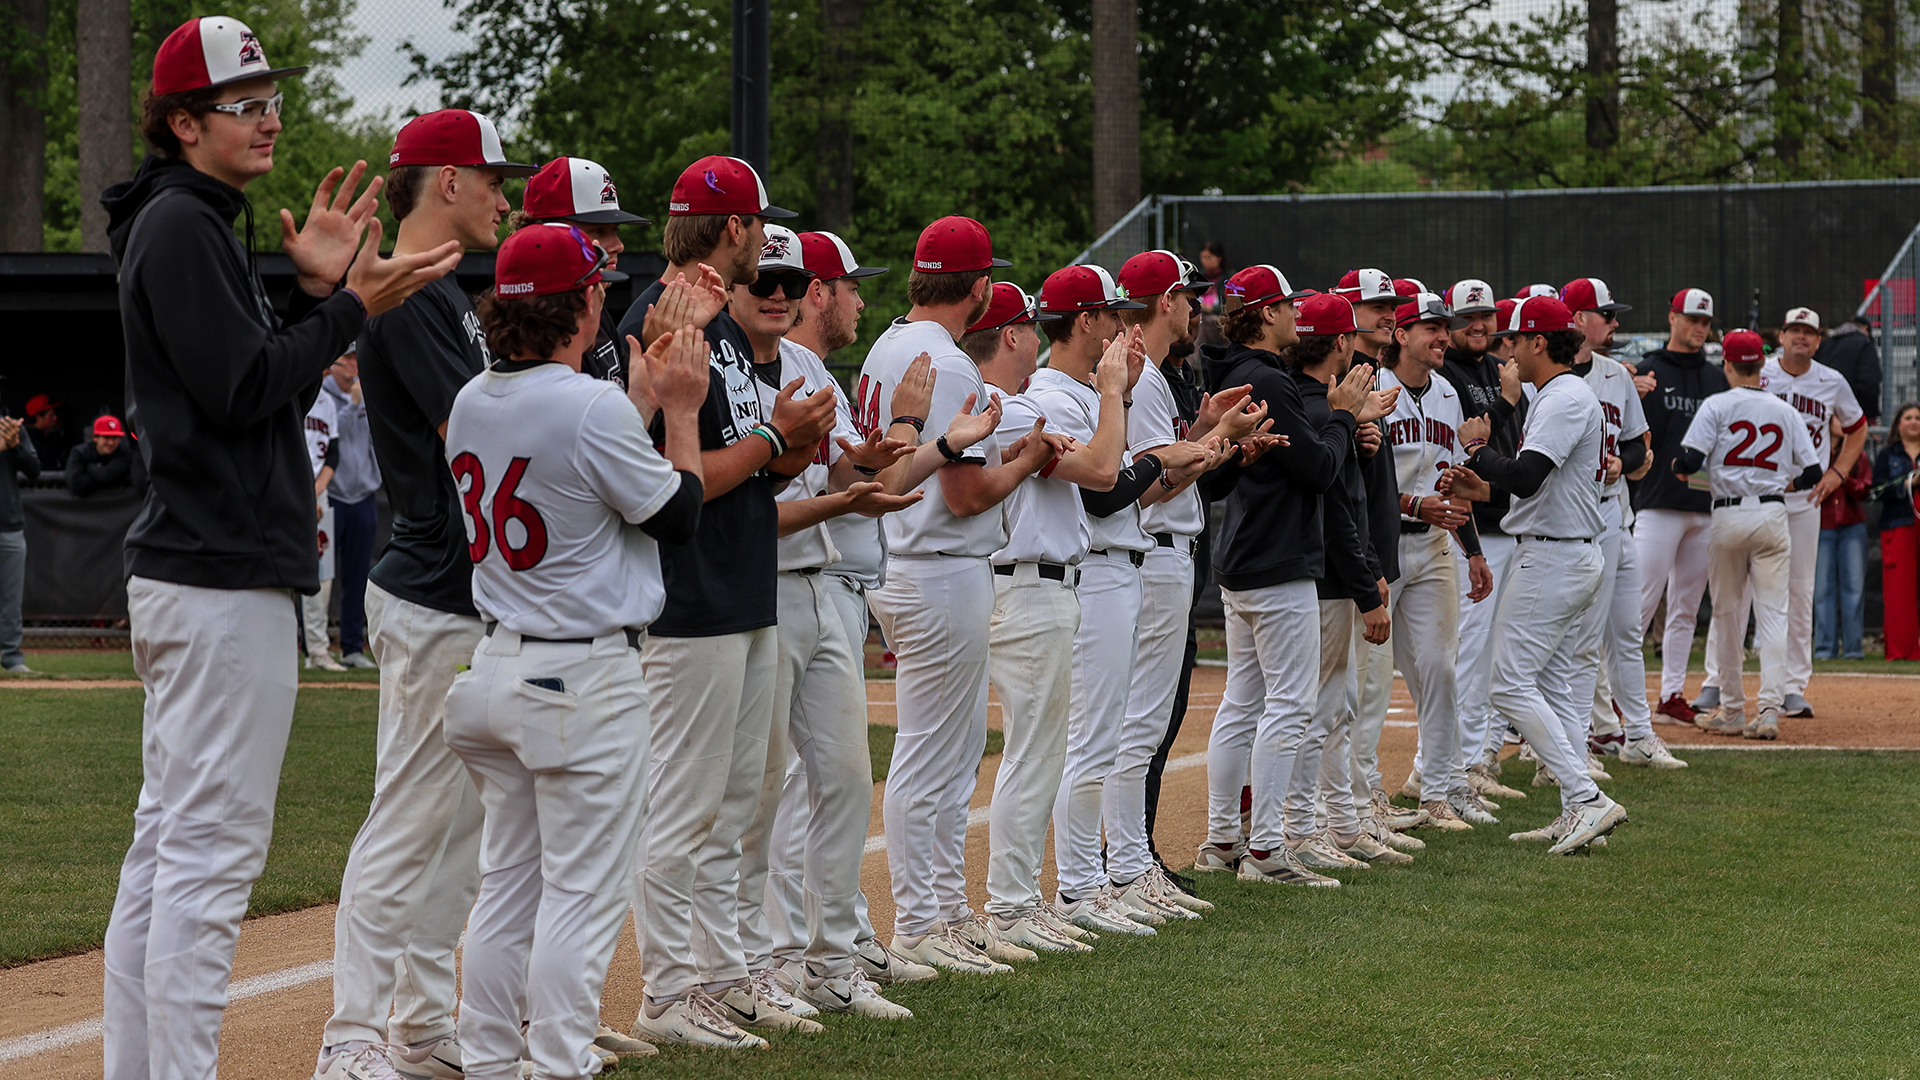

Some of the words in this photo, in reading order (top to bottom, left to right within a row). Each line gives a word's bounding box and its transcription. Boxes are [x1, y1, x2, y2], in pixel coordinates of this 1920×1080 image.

[917, 260, 942, 269] HOUNDS
[500, 282, 534, 295] HOUNDS
[1723, 420, 1783, 472] 22
[451, 451, 548, 571] 36
